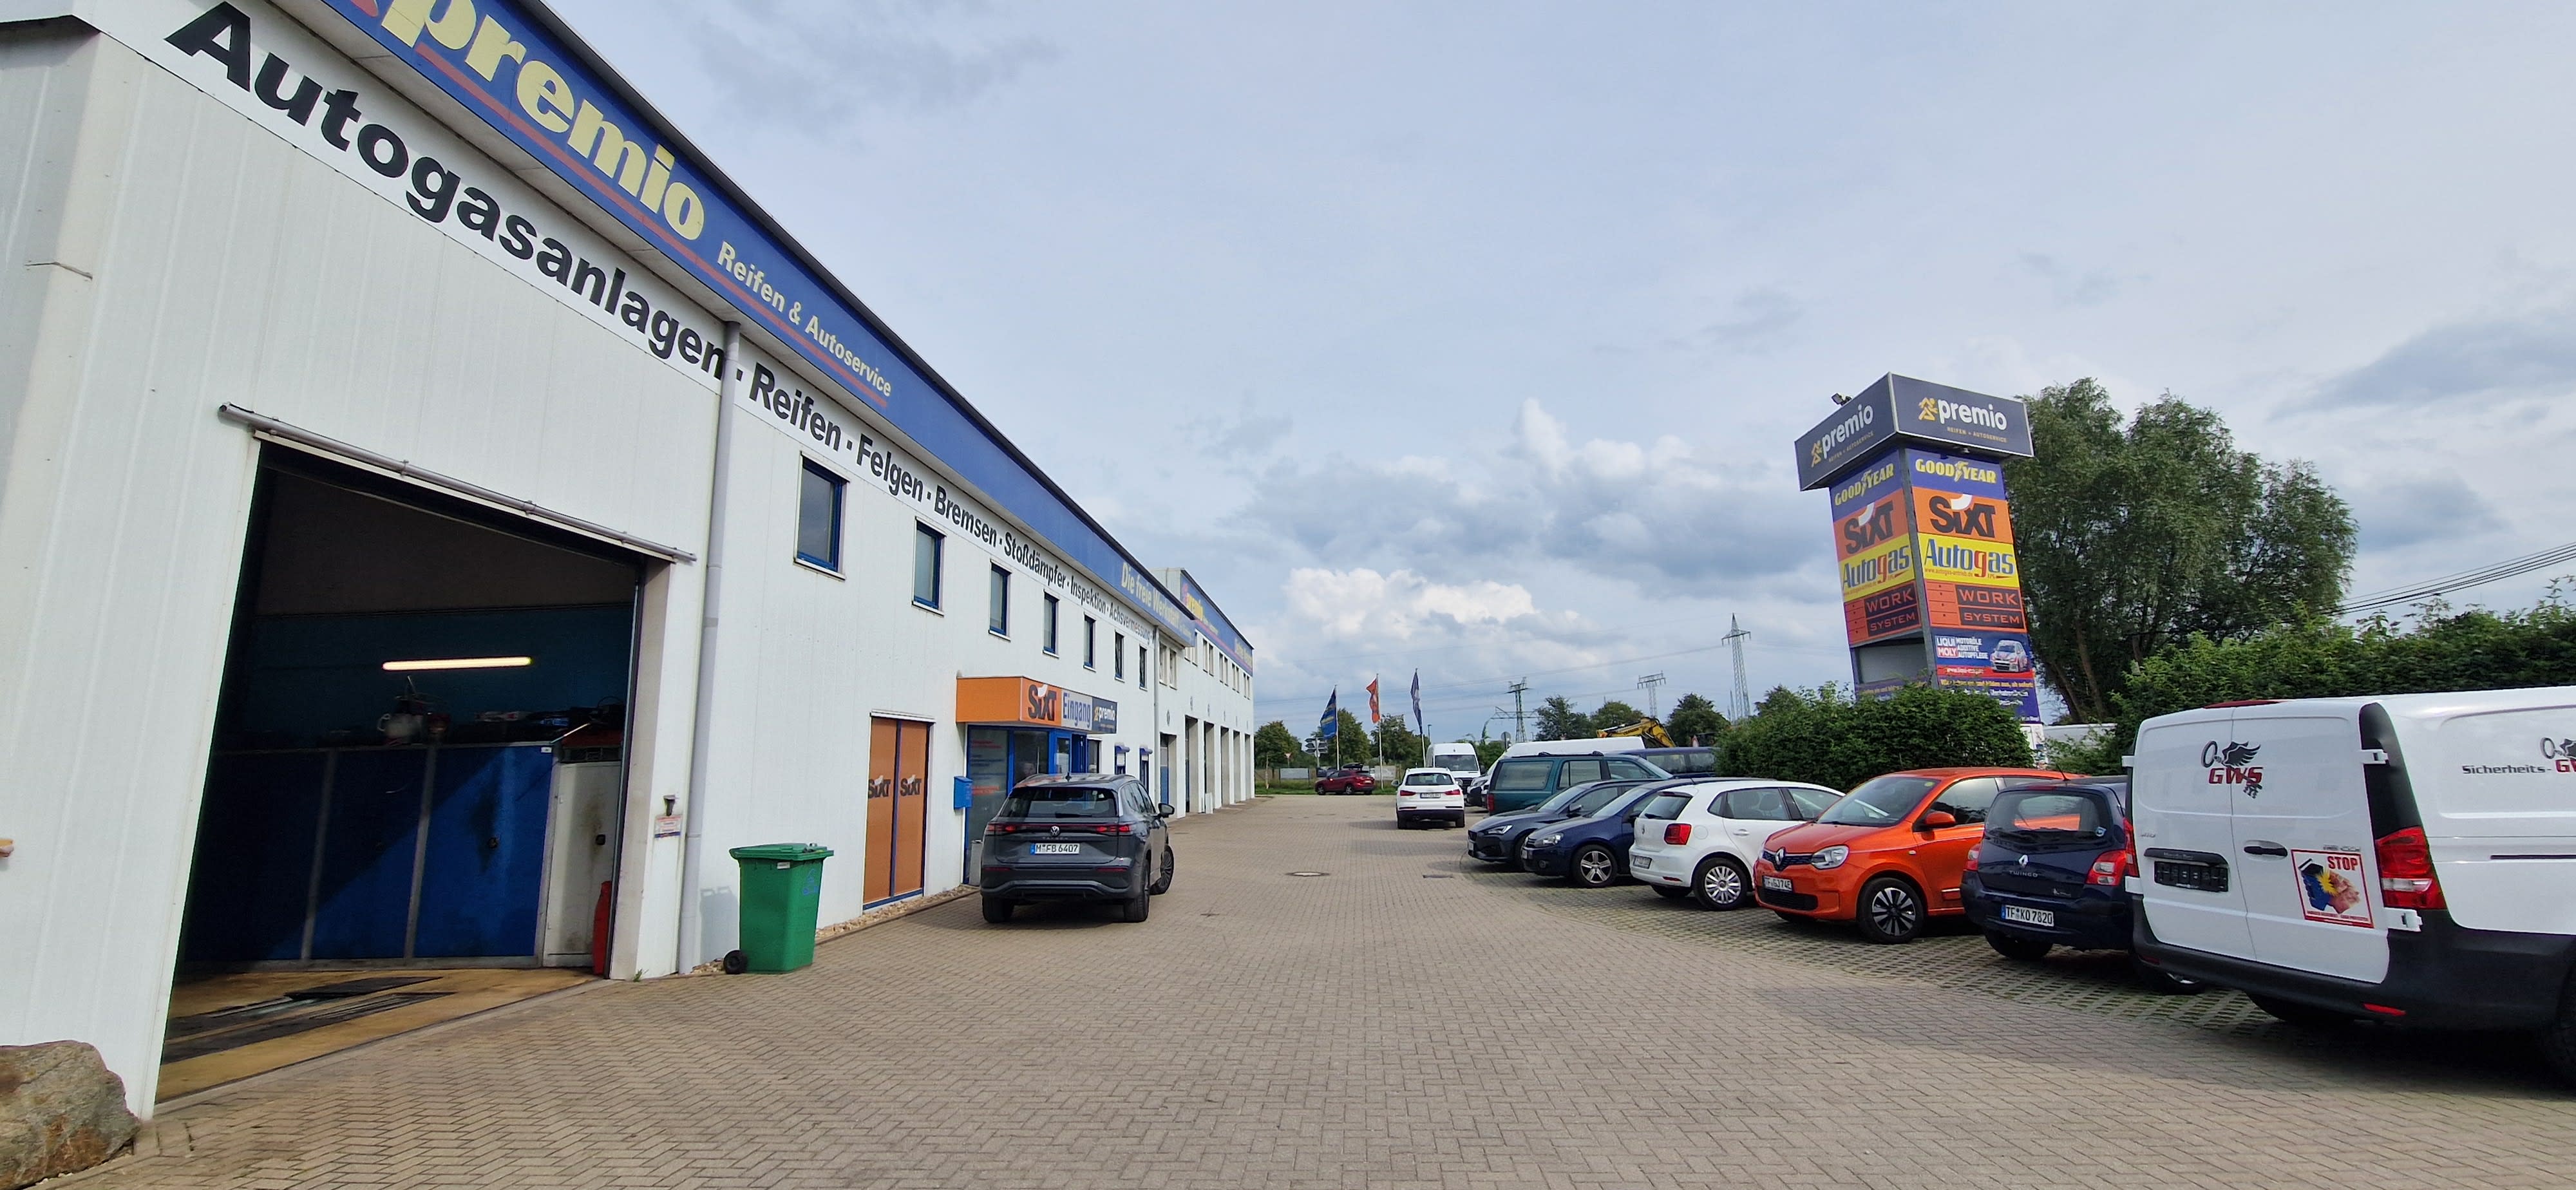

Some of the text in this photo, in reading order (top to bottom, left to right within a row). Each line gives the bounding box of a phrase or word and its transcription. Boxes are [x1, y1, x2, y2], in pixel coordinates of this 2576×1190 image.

[381, 0, 705, 240] premio
[164, 1, 724, 381] Autogasanlagen
[749, 362, 841, 452] Reifen
[857, 433, 923, 503] Felgen
[934, 485, 997, 547] Bremsen
[1005, 532, 1066, 589] Stoßdämpfer
[1070, 575, 1106, 614] Inspektion
[717, 241, 891, 396] Reifen & Autoservice
[1938, 399, 2007, 430] premio
[1822, 404, 1873, 459] premio
[1842, 545, 1910, 590] Autogas
[1924, 538, 2013, 578] Autogas
[1867, 588, 1914, 612] WORK
[1959, 589, 2018, 605] WORK
[1870, 612, 1915, 631] SYSTEM
[1964, 612, 2020, 624] SYSTEM
[1937, 638, 1956, 647] LIQUI
[1938, 647, 1956, 656] MOLY
[1063, 692, 1091, 728] Eingang
[2209, 766, 2263, 784] GWS
[2462, 764, 2552, 774] Sicherheits-
[1058, 844, 1078, 853] 6407
[2327, 856, 2358, 871] STOP
[2006, 906, 2015, 918] TF
[2032, 911, 2052, 924] 7820
